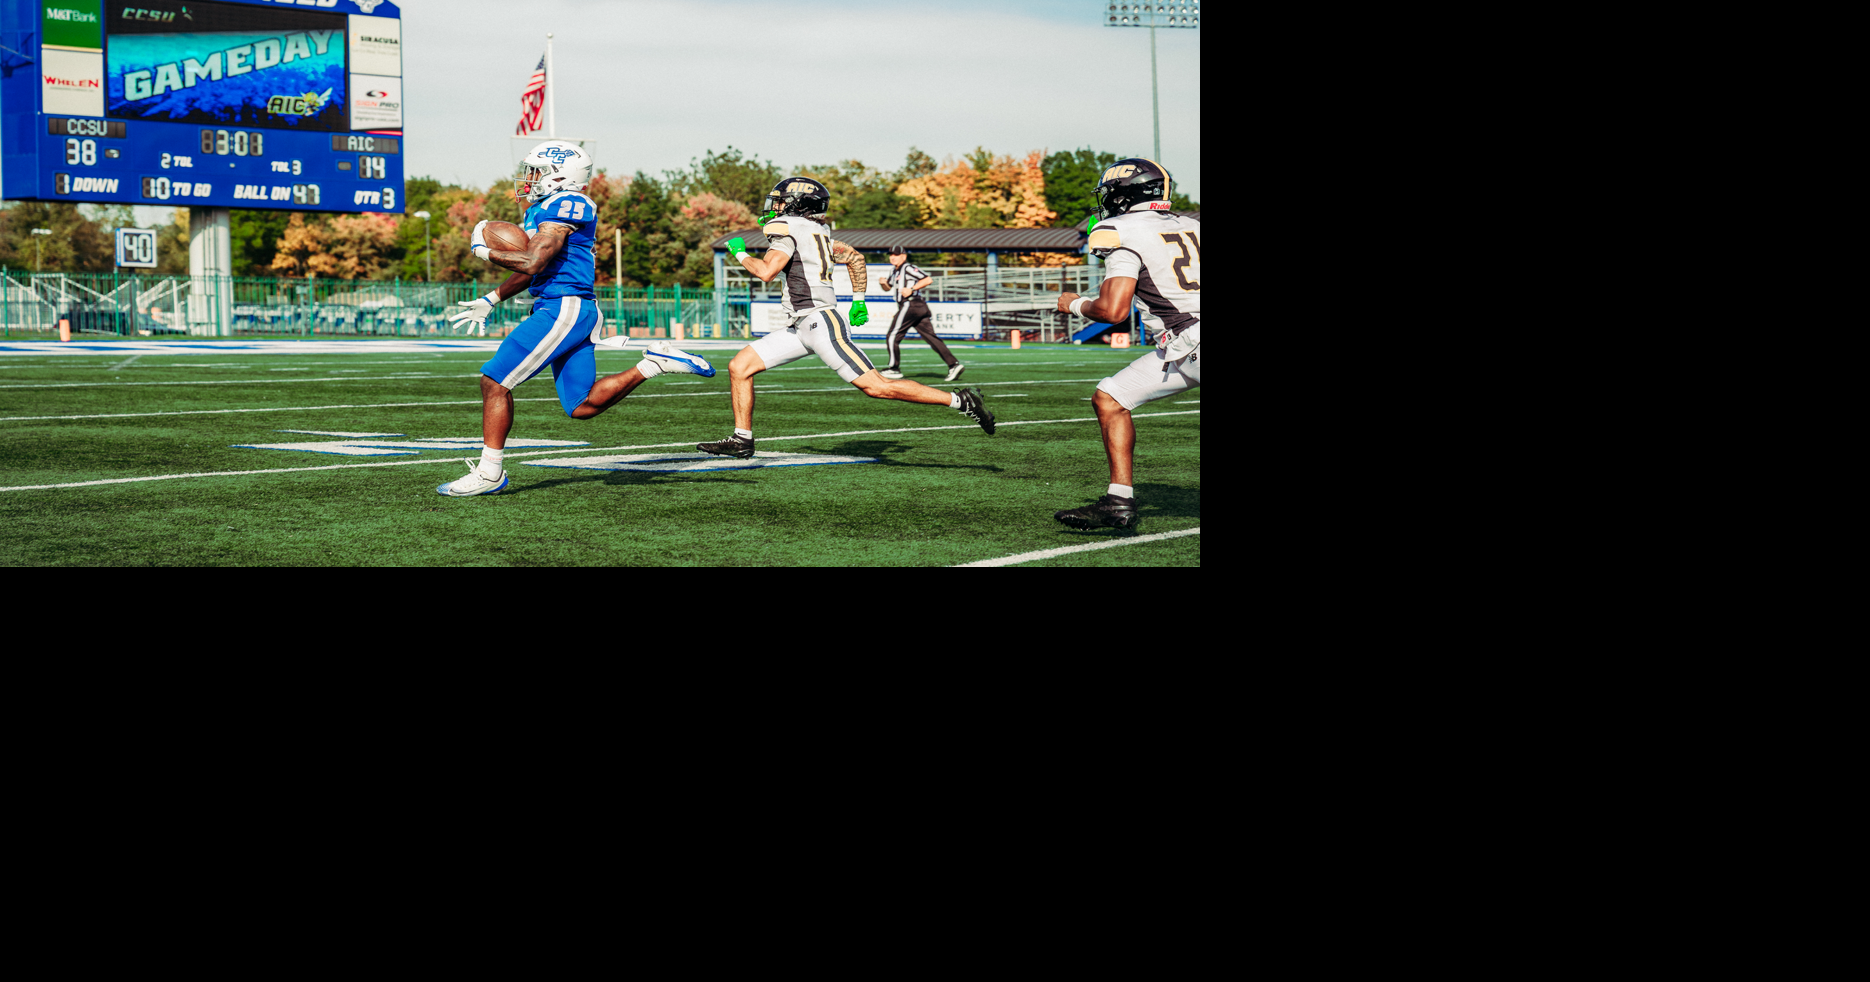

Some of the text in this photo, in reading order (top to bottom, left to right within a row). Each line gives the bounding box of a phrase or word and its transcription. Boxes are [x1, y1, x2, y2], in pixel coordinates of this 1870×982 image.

[122, 7, 176, 23] CCSU
[124, 29, 334, 101] GAMEDAY
[267, 95, 306, 115] AIC
[379, 101, 399, 109] PRO
[67, 118, 108, 136] CCSU
[66, 138, 97, 166] 38
[347, 135, 375, 151] AIC
[161, 153, 193, 169] 2 TOL
[270, 160, 302, 175] TOL 3
[363, 156, 386, 179] 14
[1102, 164, 1137, 184] AIC
[72, 177, 119, 193] DOWN
[148, 177, 212, 200] 10 TO GO
[233, 184, 320, 205] BALL ON 47
[786, 182, 815, 194] AIC
[353, 187, 396, 209] QTR 3
[557, 200, 586, 220] 25
[124, 234, 152, 262] 40
[930, 313, 974, 322] ERTY
